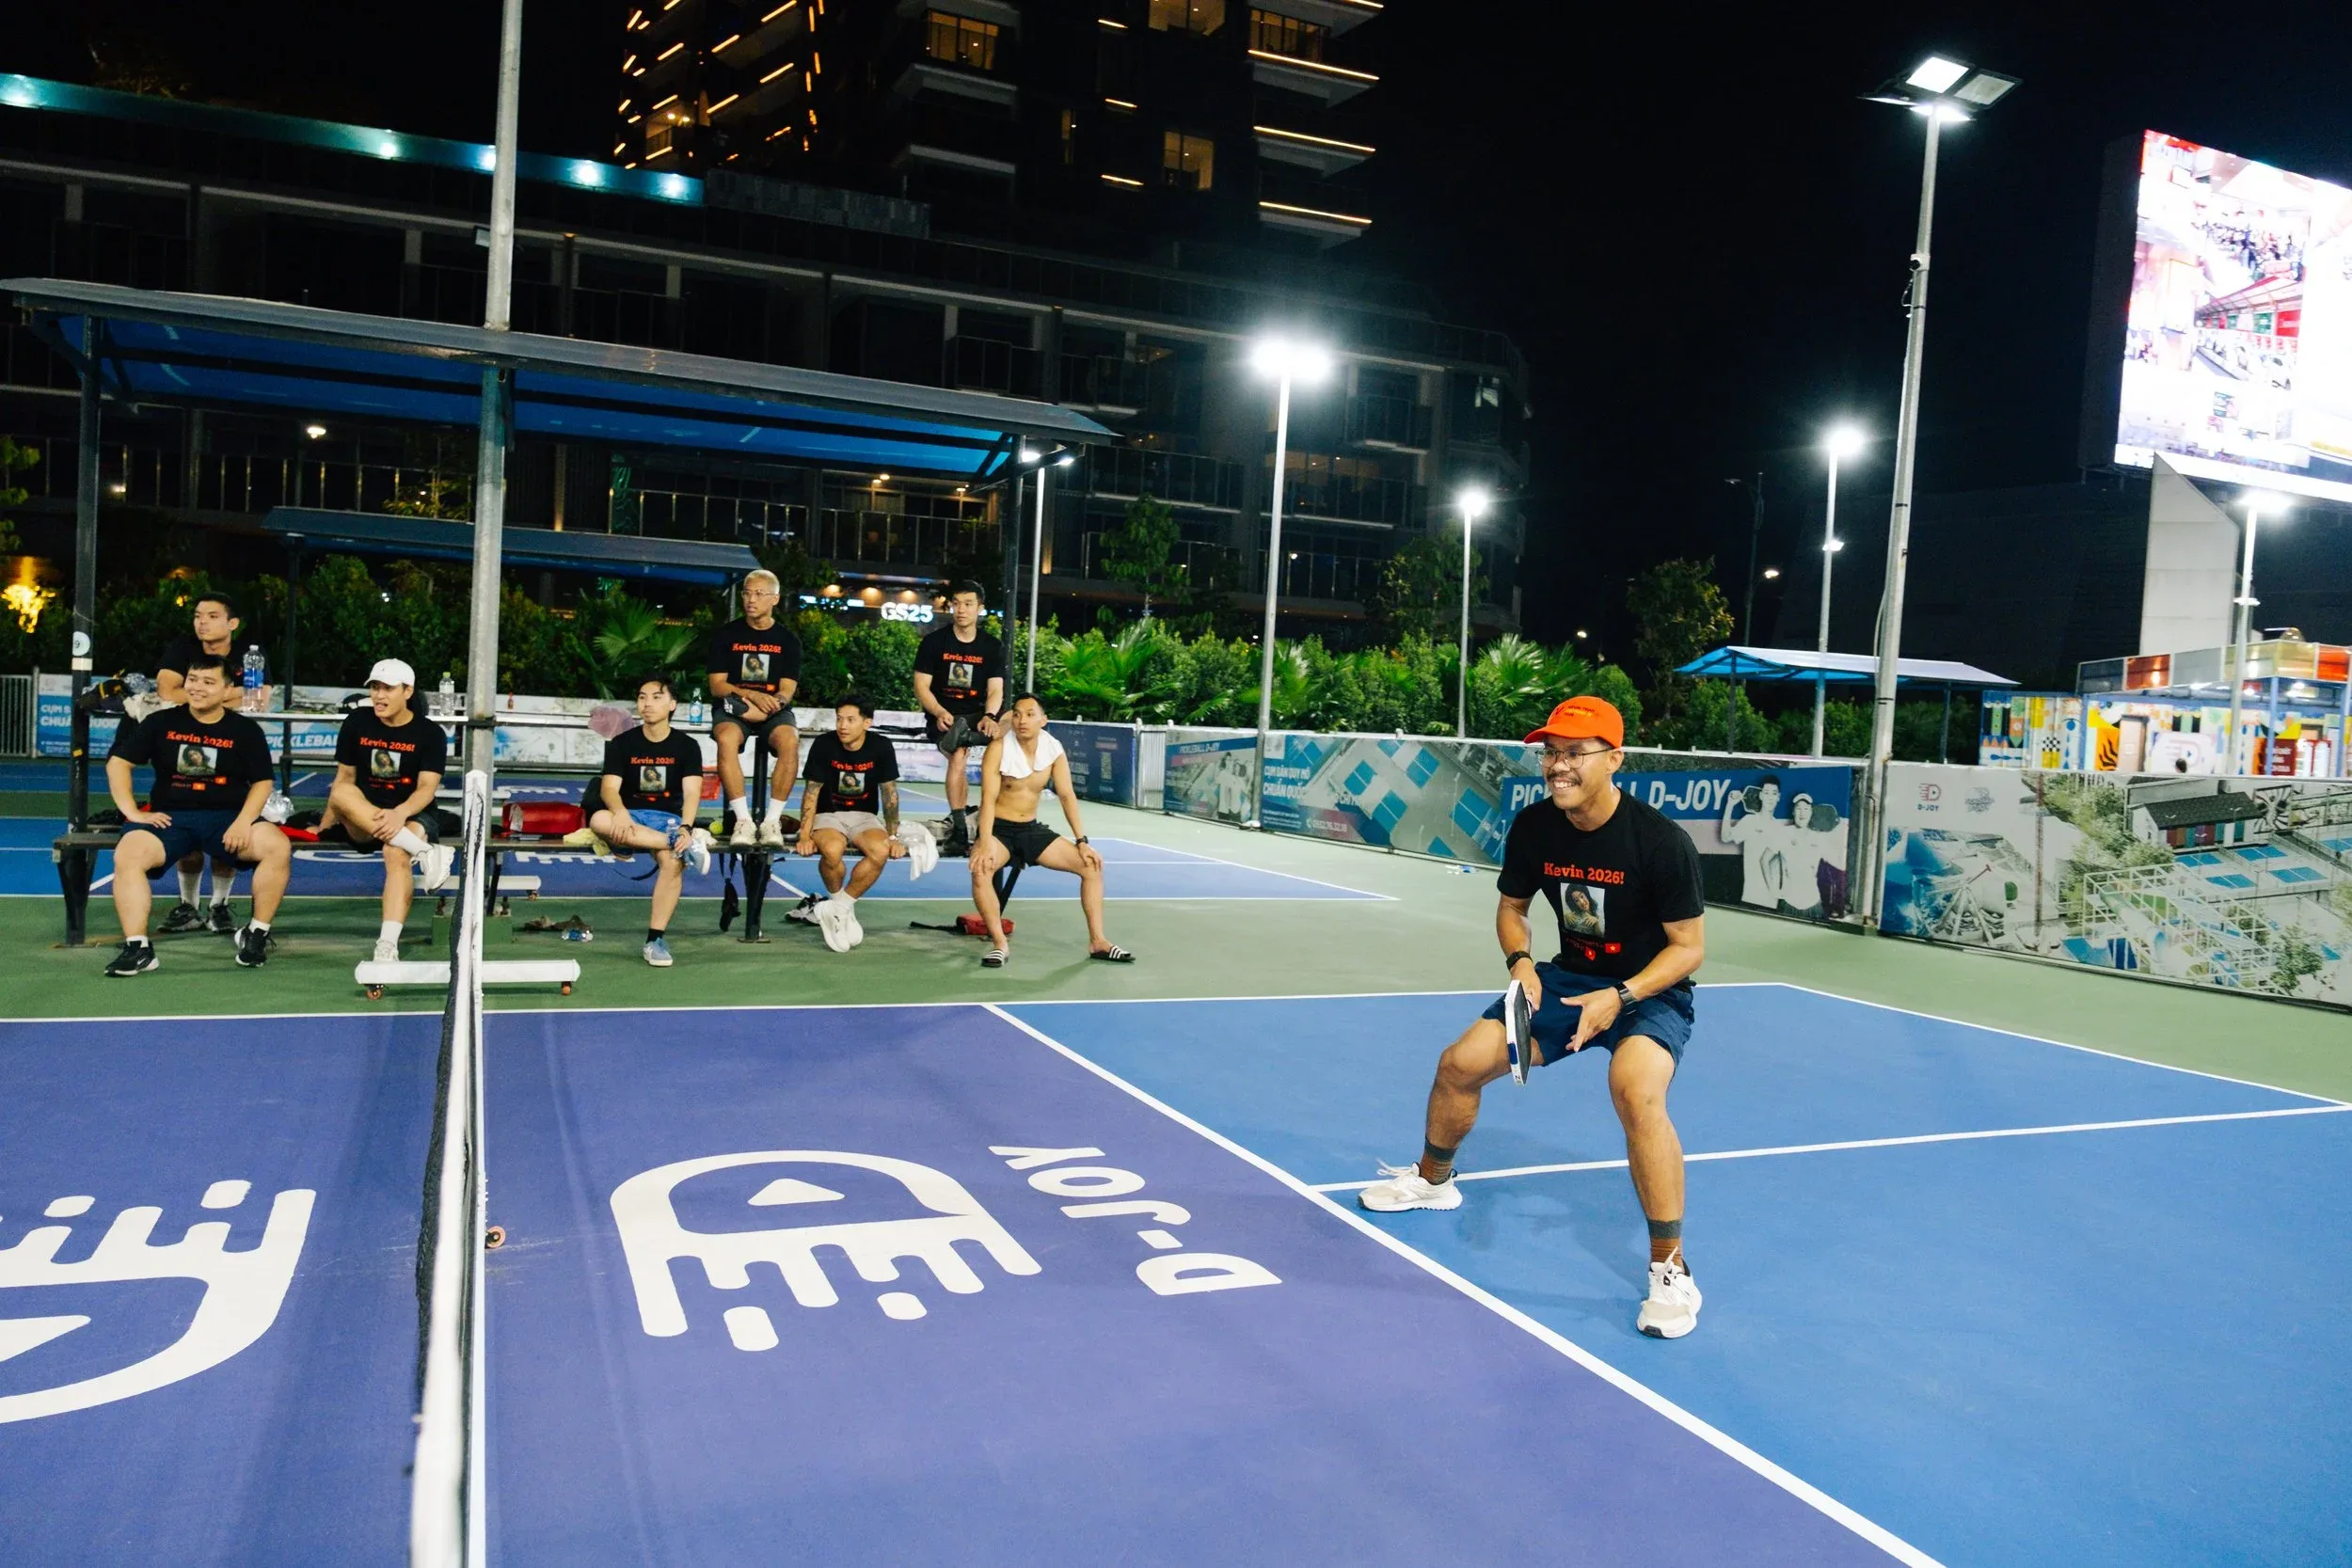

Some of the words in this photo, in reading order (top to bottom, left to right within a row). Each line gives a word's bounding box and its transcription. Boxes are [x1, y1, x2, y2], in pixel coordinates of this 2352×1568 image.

[881, 602, 934, 623] GS25
[732, 642, 757, 652] Kevin
[167, 731, 201, 744] Kevin
[203, 736, 234, 749] 2026!
[359, 736, 388, 749] Kevin
[389, 741, 415, 752] 2026!
[630, 755, 654, 765] Kevin
[1648, 779, 1731, 811] D-JOY
[1544, 862, 1585, 879] Kevin
[1587, 867, 1625, 885] 2026!
[988, 1145, 1283, 1296] D-JOY
